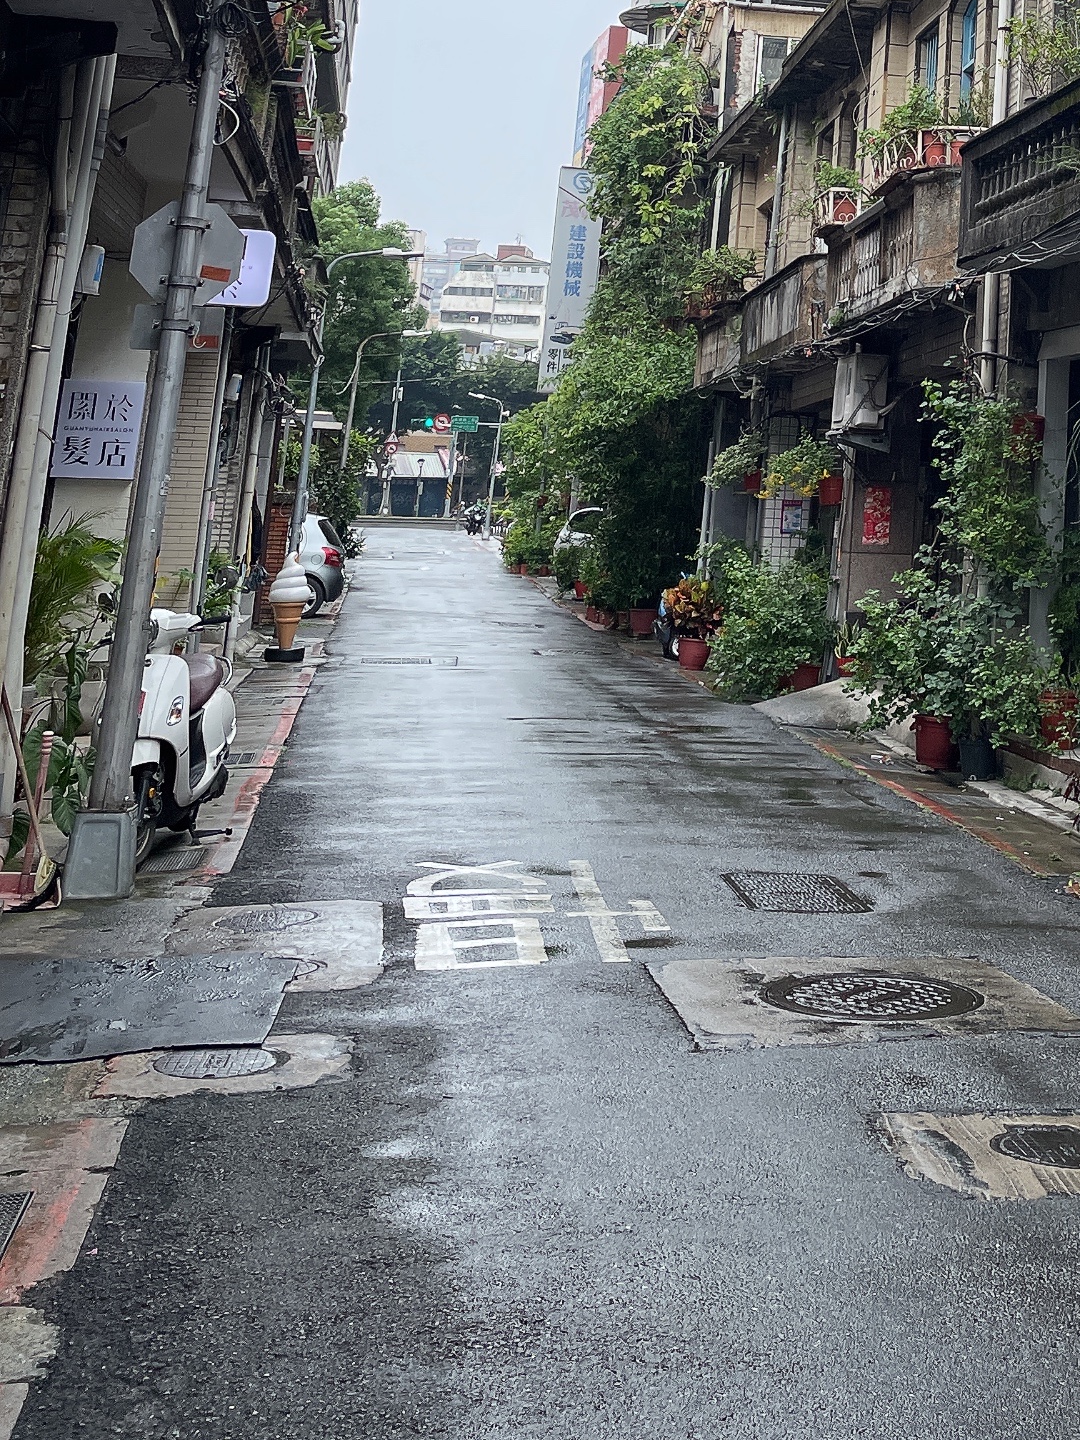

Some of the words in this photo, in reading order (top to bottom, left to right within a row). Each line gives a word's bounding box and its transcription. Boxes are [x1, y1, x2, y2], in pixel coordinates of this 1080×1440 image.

[563, 224, 587, 297] 建設機械
[547, 348, 559, 373] 零件
[68, 392, 133, 421] 關於
[61, 436, 131, 467] 髮店
